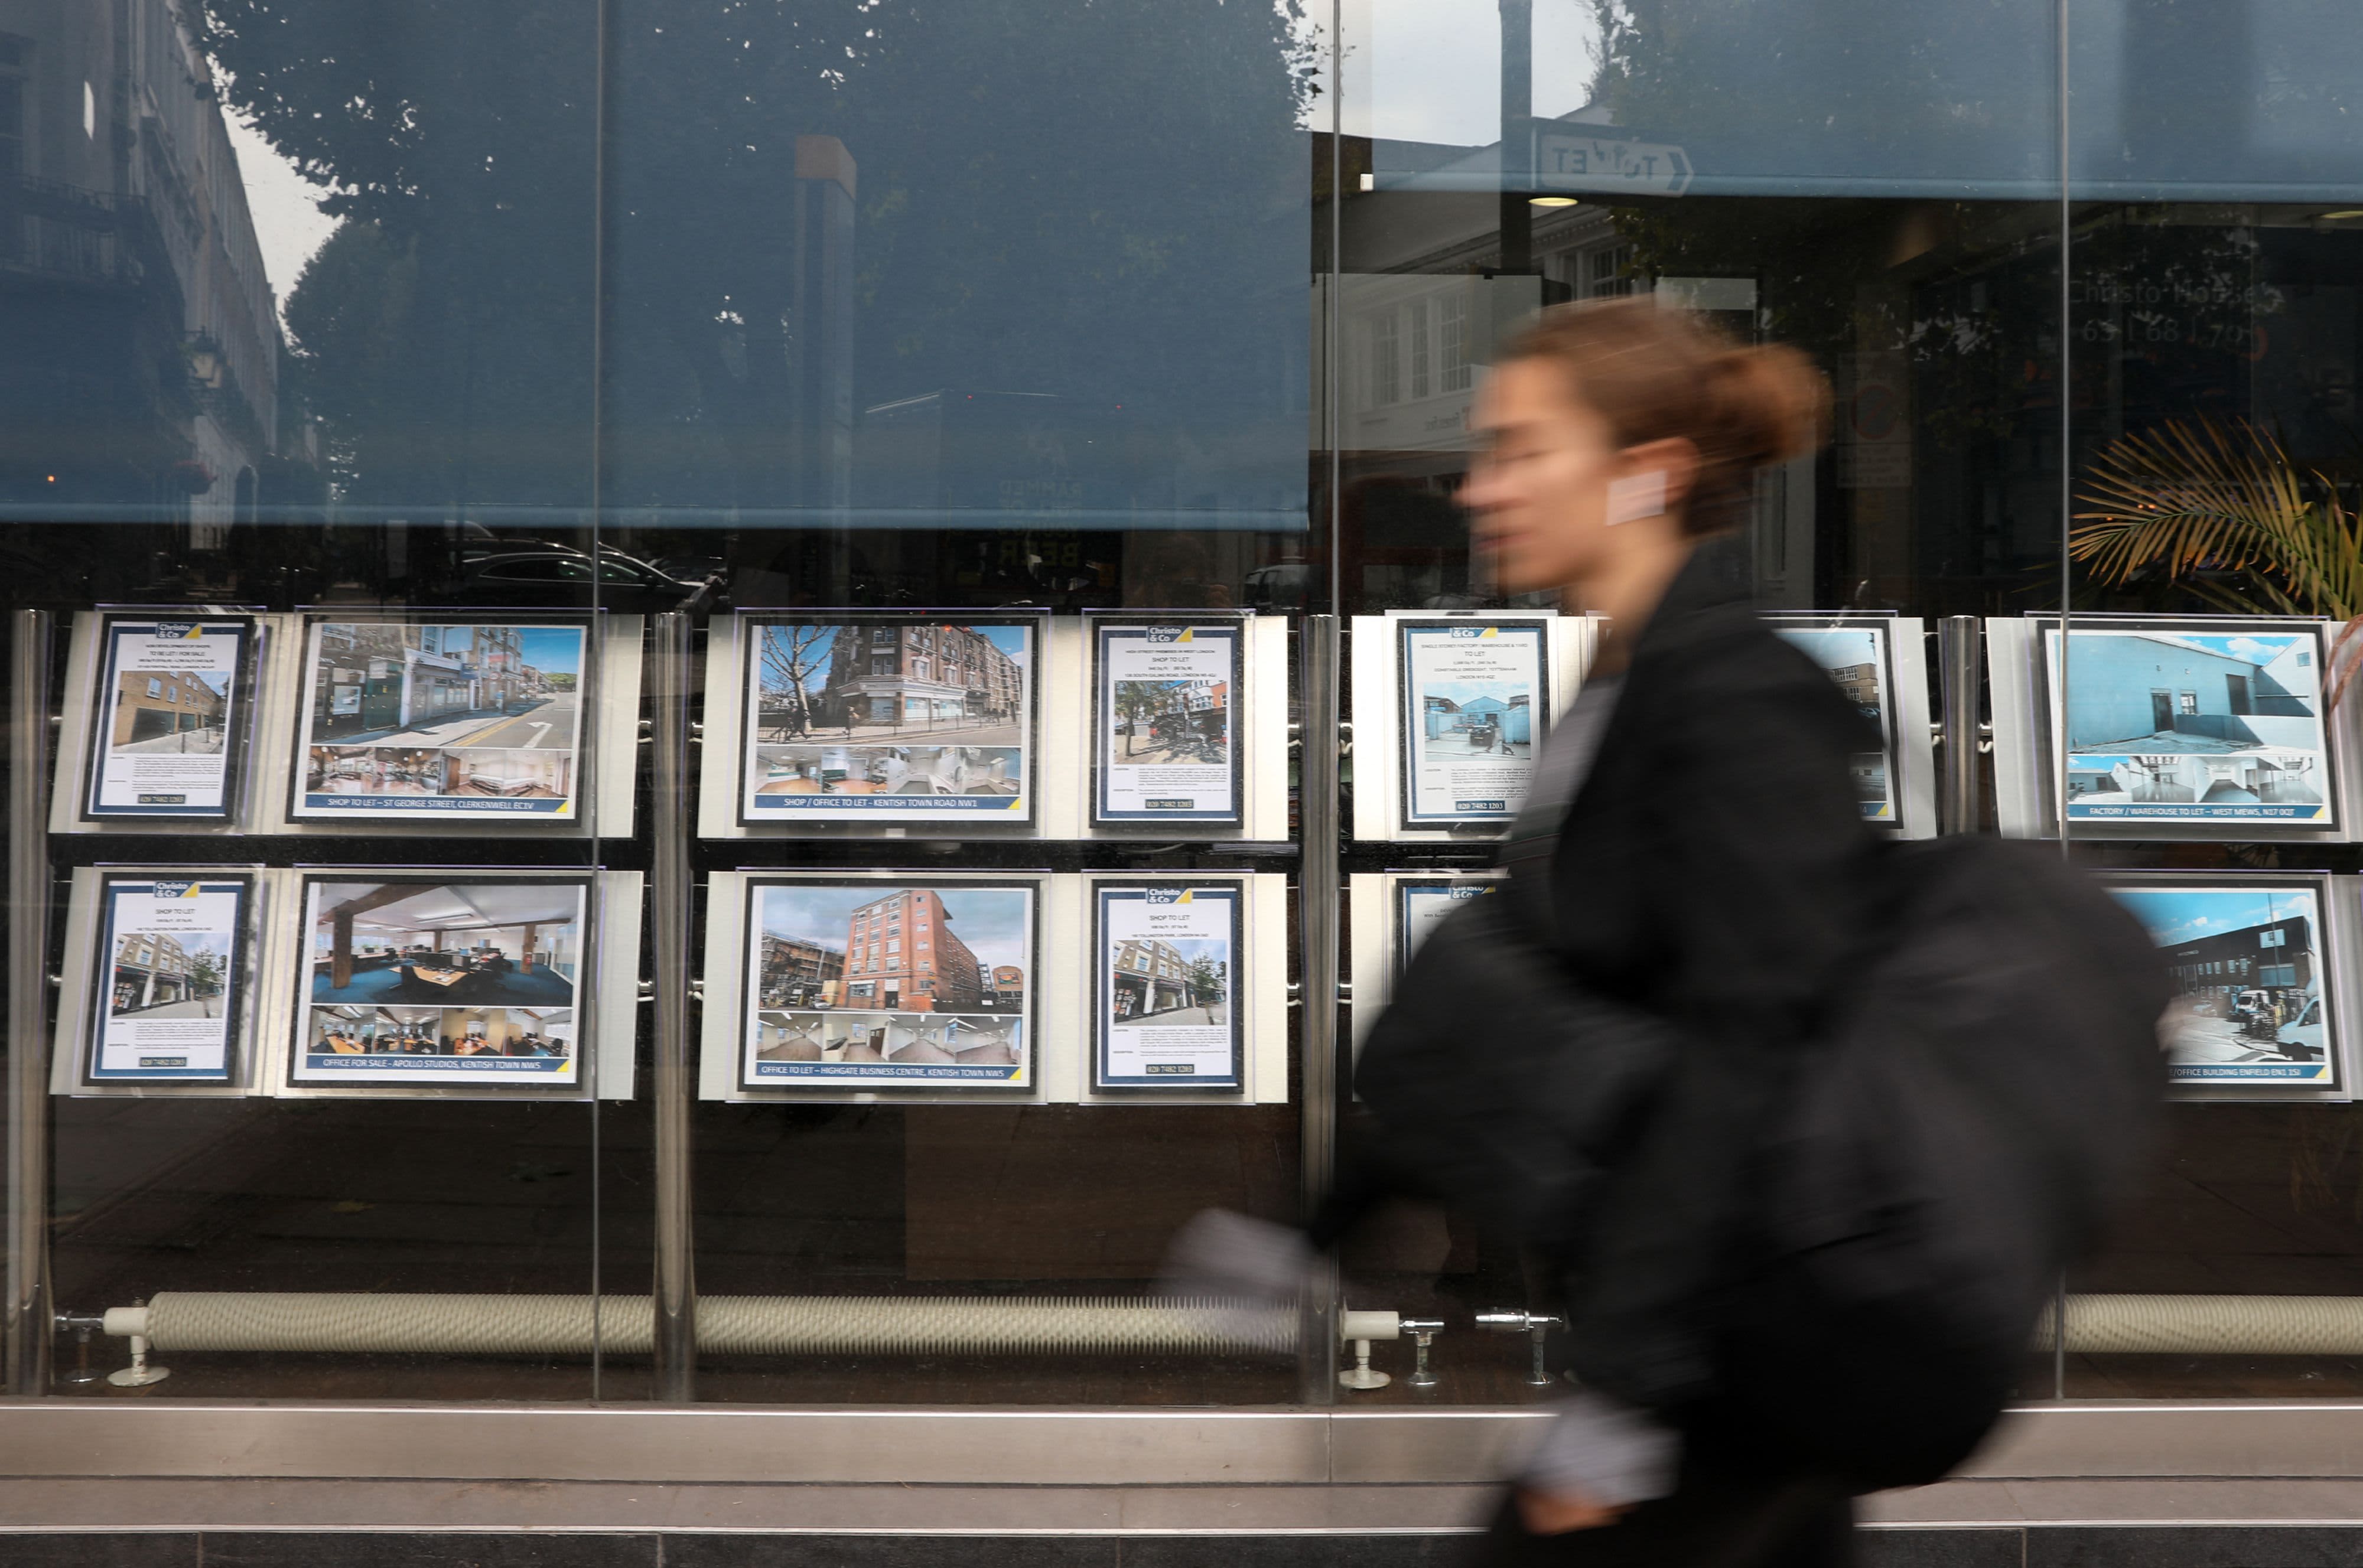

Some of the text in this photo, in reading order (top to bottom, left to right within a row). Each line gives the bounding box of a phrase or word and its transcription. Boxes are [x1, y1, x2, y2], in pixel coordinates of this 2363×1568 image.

[2069, 281, 2161, 303] Christo
[2146, 319, 2179, 341] 68
[427, 800, 457, 809] STREET,
[424, 1060, 461, 1069] STUDIOS,
[895, 1068, 926, 1077] CENTRE,
